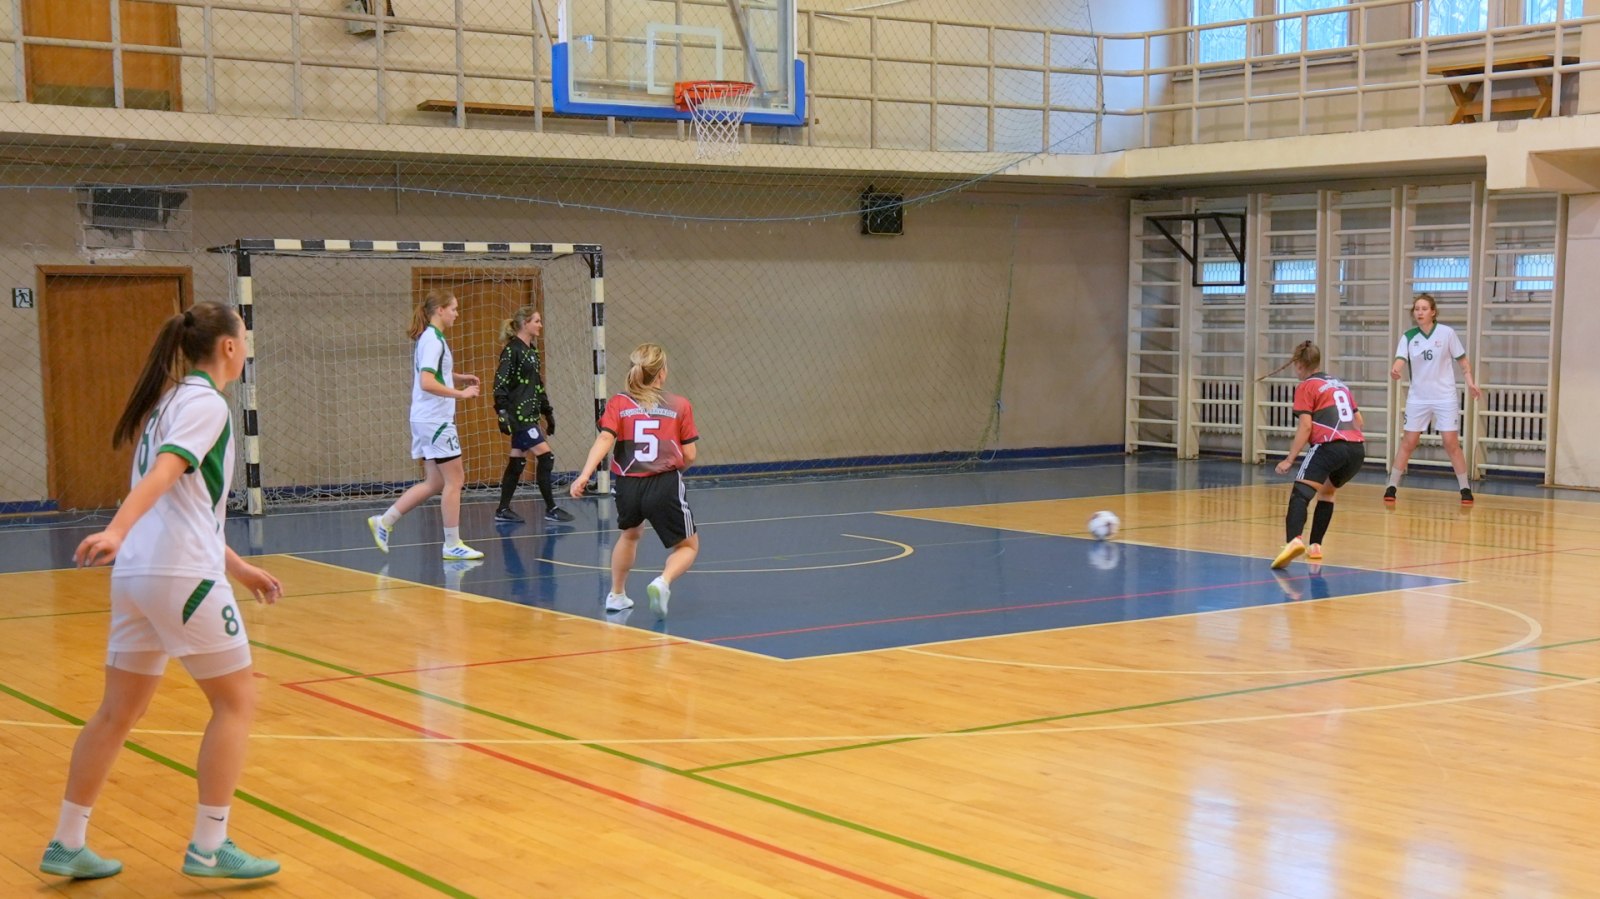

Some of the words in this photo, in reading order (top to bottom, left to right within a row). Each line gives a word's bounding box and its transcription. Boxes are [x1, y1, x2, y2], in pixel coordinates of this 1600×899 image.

[1421, 349, 1433, 361] 16
[446, 435, 460, 451] 13
[634, 419, 660, 462] 5
[221, 604, 240, 637] 8
